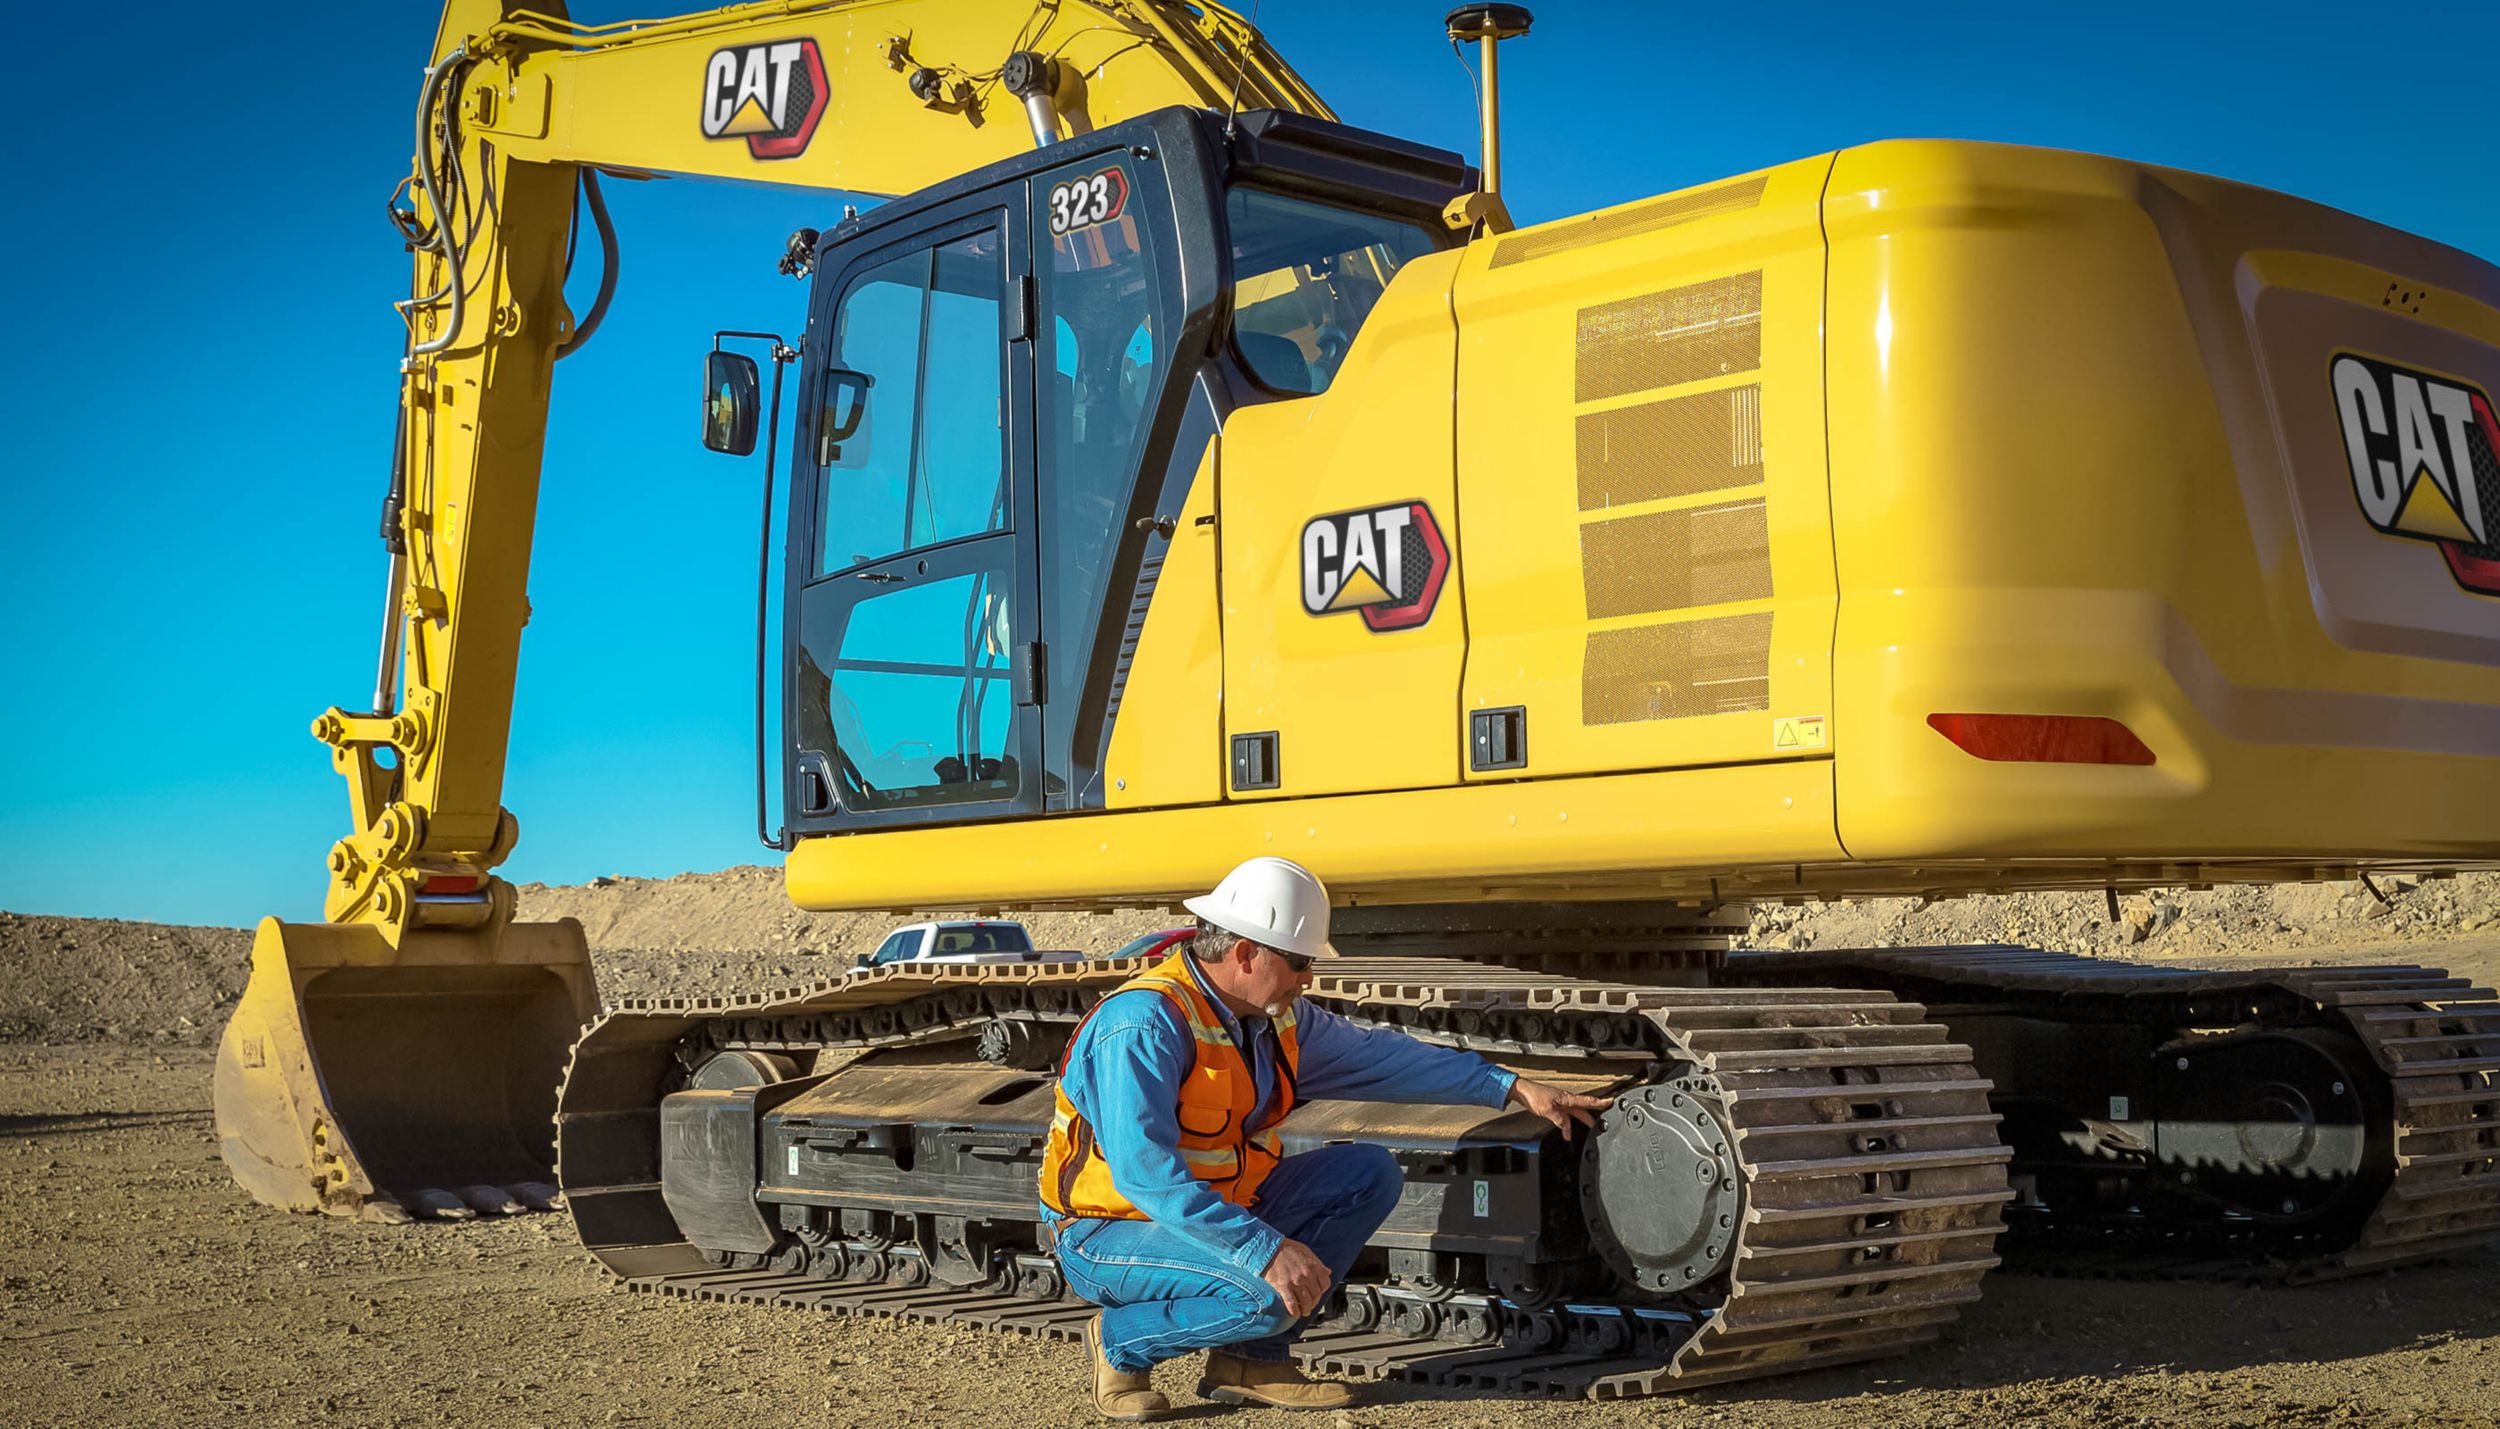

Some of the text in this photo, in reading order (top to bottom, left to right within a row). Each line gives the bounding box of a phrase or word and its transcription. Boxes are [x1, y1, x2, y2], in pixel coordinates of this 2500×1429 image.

[703, 41, 802, 135] CAT
[1052, 174, 1108, 232] 323
[2333, 358, 2488, 545] CAT
[1303, 506, 1411, 611] CAT
